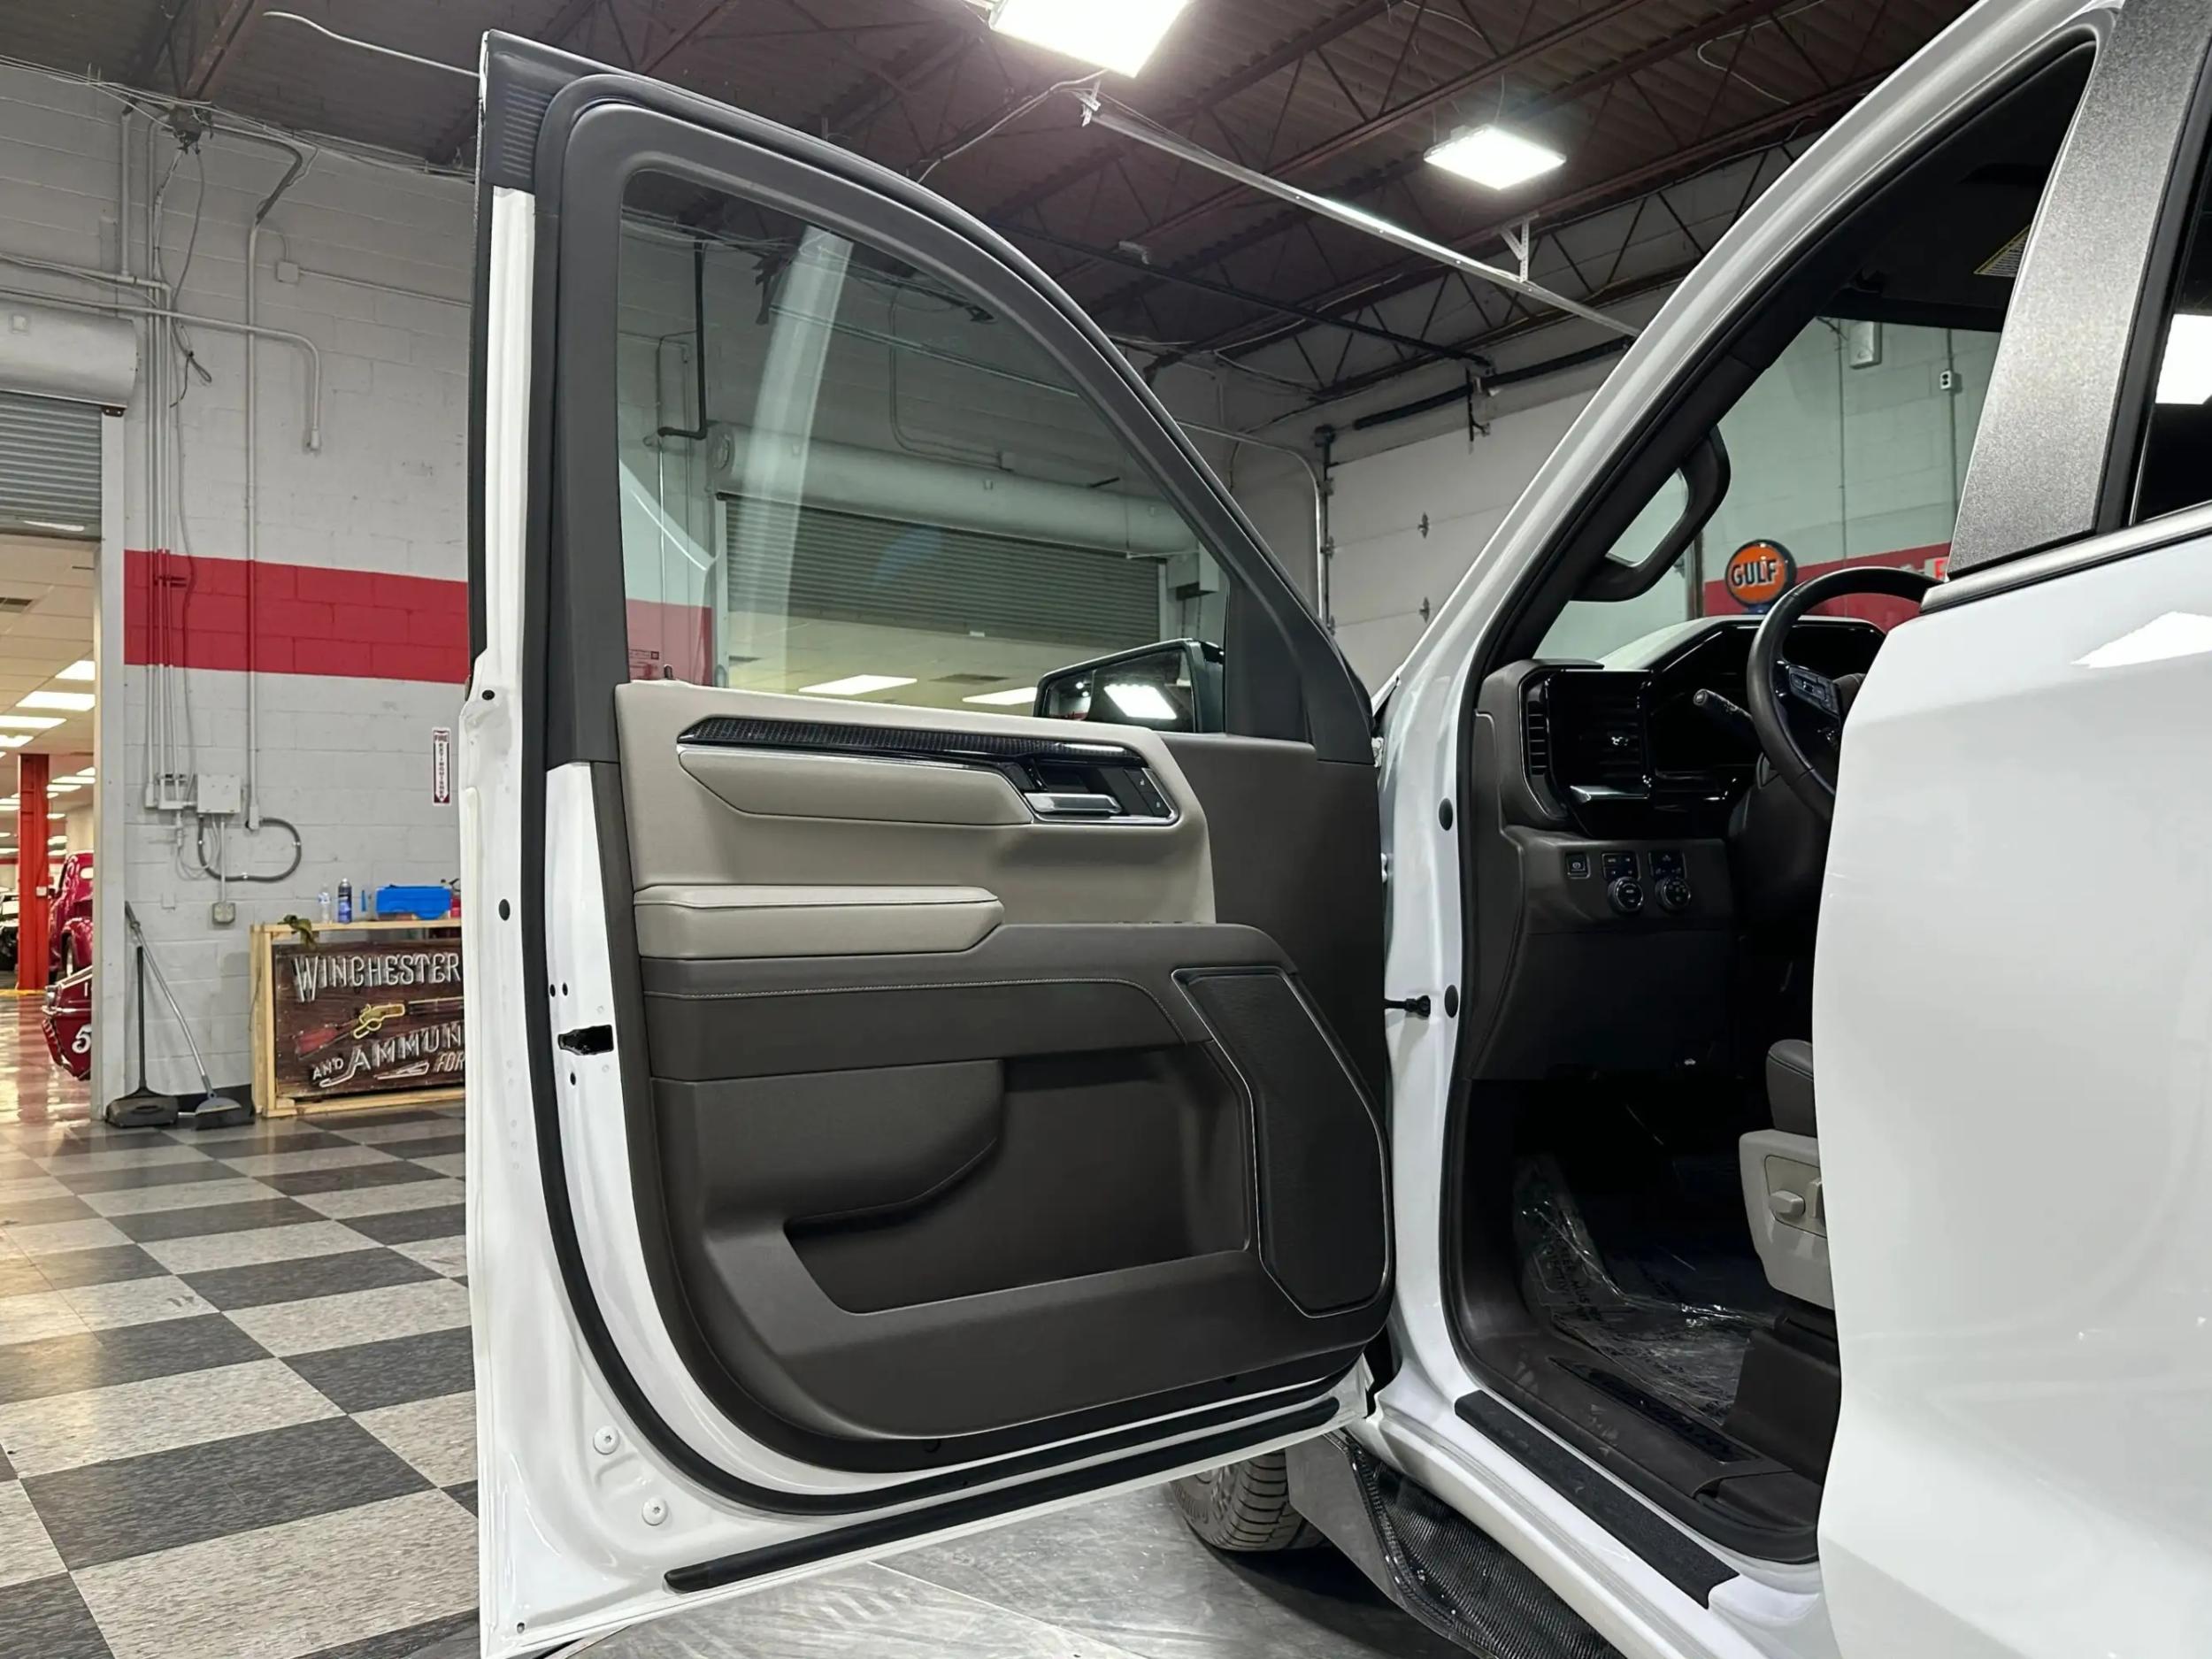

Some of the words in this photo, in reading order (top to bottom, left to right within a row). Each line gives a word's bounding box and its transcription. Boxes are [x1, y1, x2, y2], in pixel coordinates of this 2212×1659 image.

[1732, 558, 1778, 587] GULF
[294, 953, 461, 1002] WINCHESTER
[312, 1056, 343, 1079] AND
